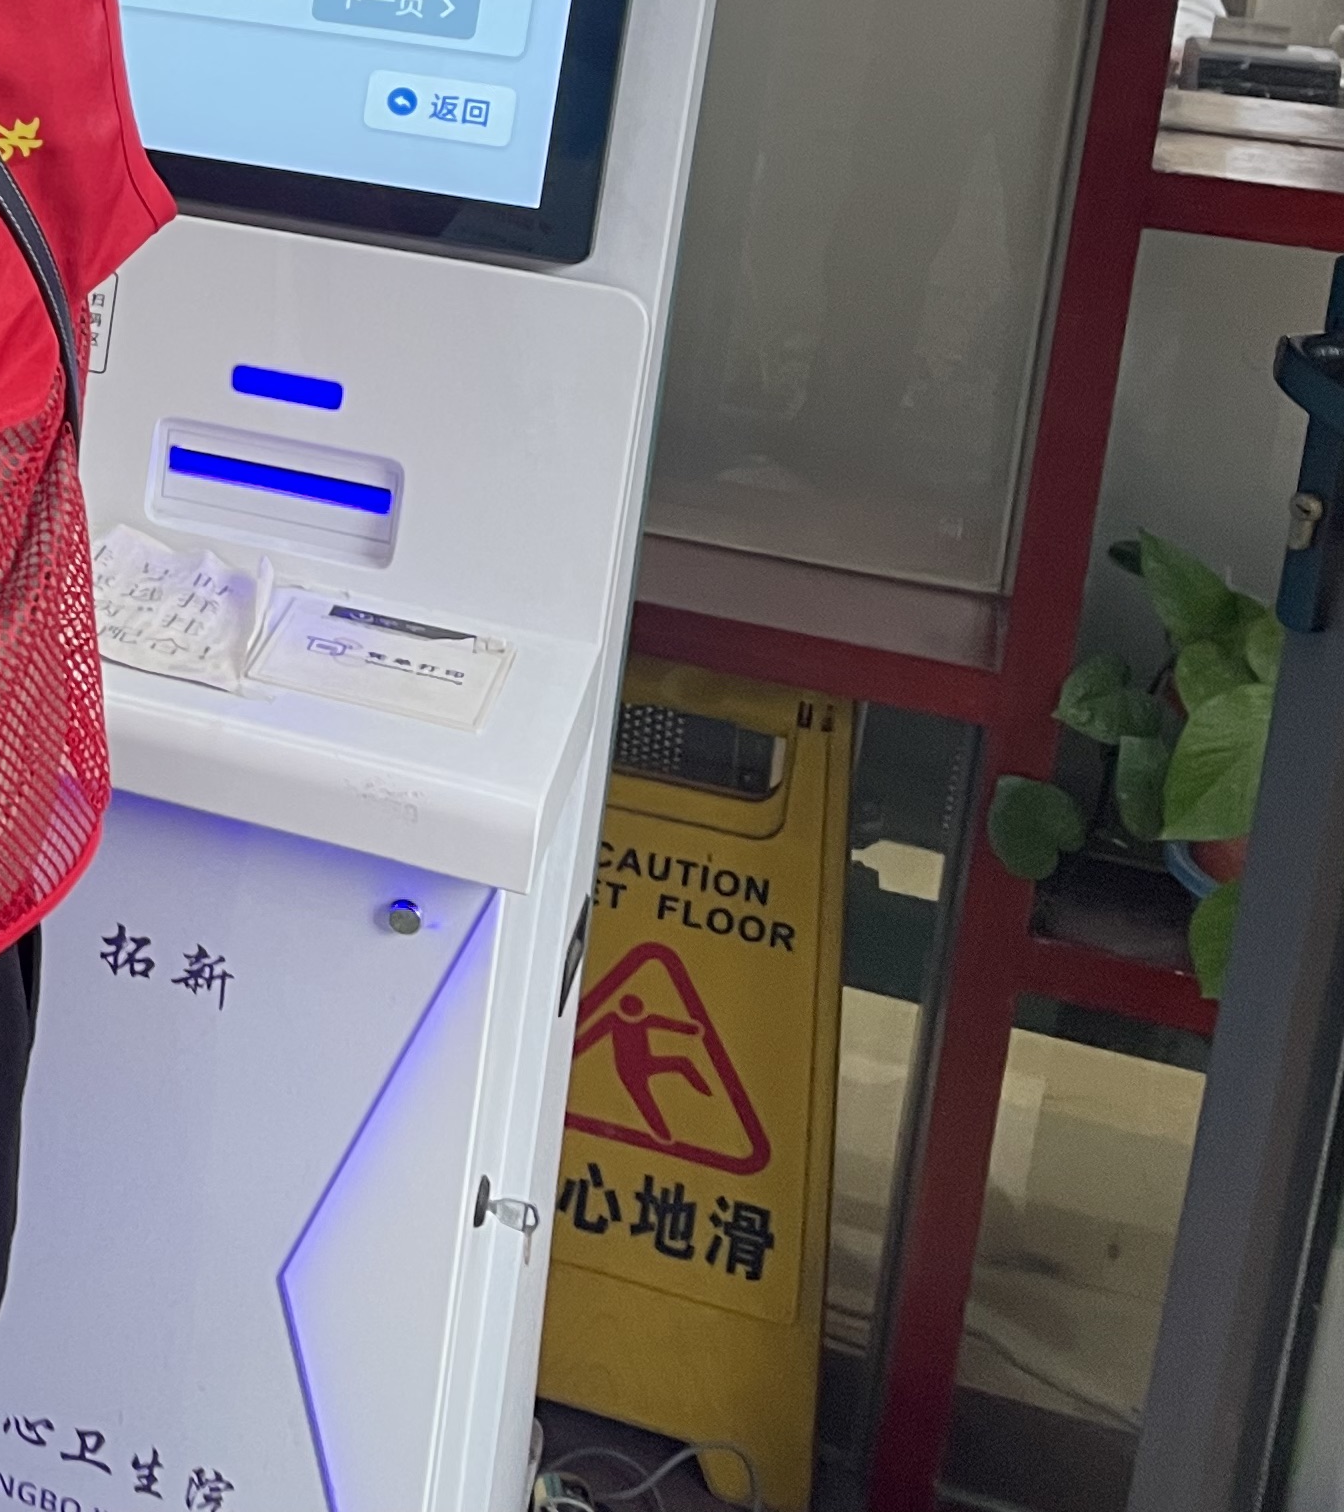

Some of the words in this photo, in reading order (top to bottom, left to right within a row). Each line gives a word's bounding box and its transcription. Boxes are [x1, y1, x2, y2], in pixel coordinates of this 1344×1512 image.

[428, 92, 491, 128] 返回
[598, 841, 770, 907] CAUTION
[657, 893, 796, 952] FLOOR
